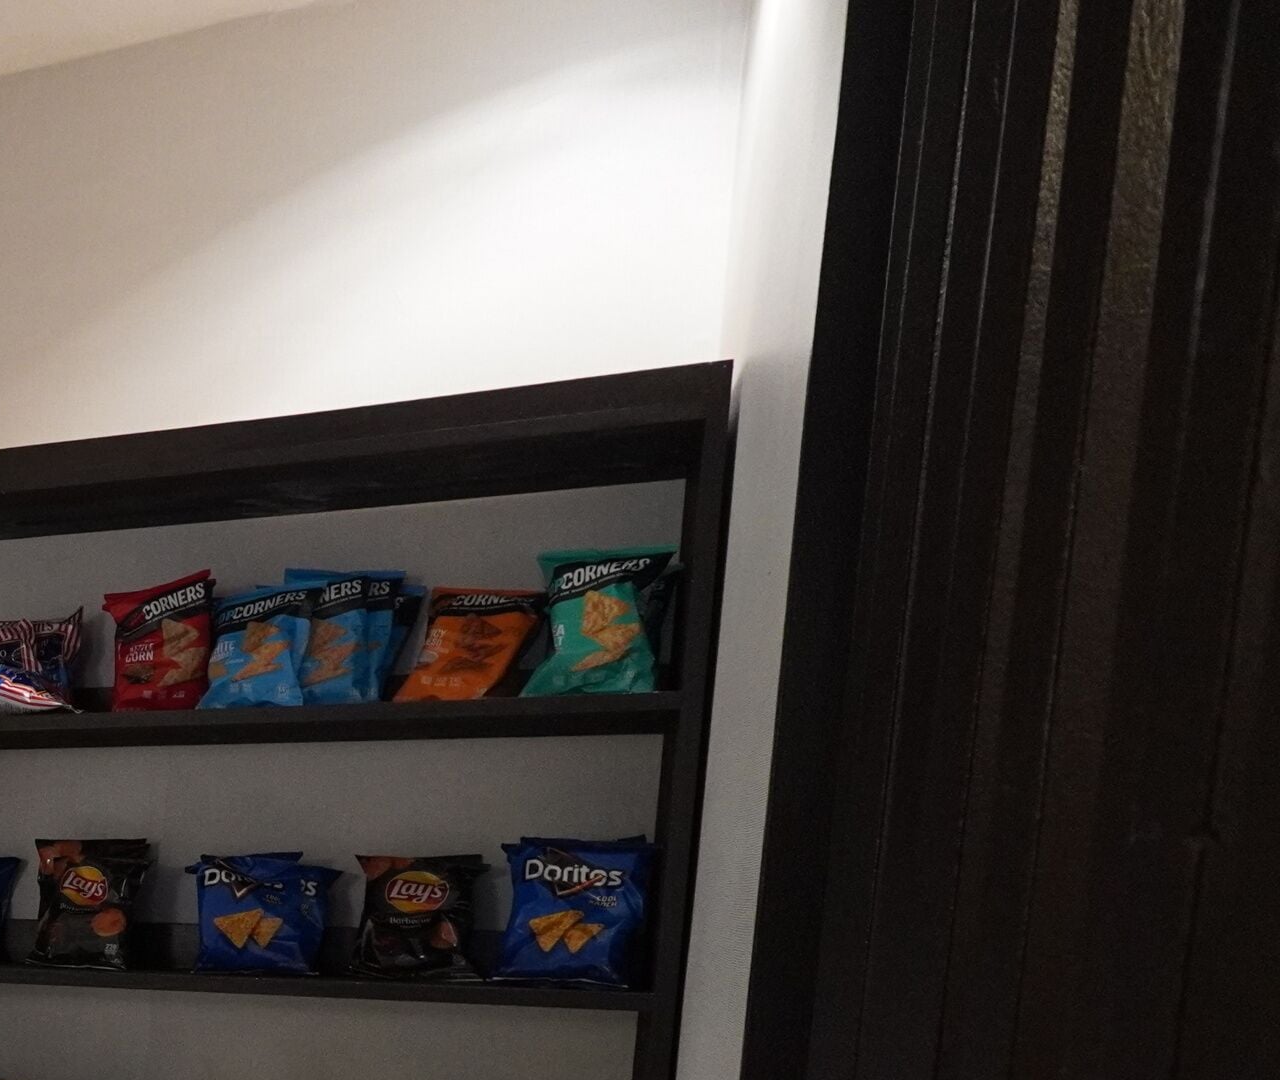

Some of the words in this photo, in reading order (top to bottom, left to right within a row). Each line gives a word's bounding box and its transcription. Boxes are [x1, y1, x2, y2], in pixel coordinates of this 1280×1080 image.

[319, 579, 363, 604] NERS
[62, 870, 107, 899] Lay's
[524, 857, 624, 888] Doritos
[389, 879, 444, 899] Lay's
